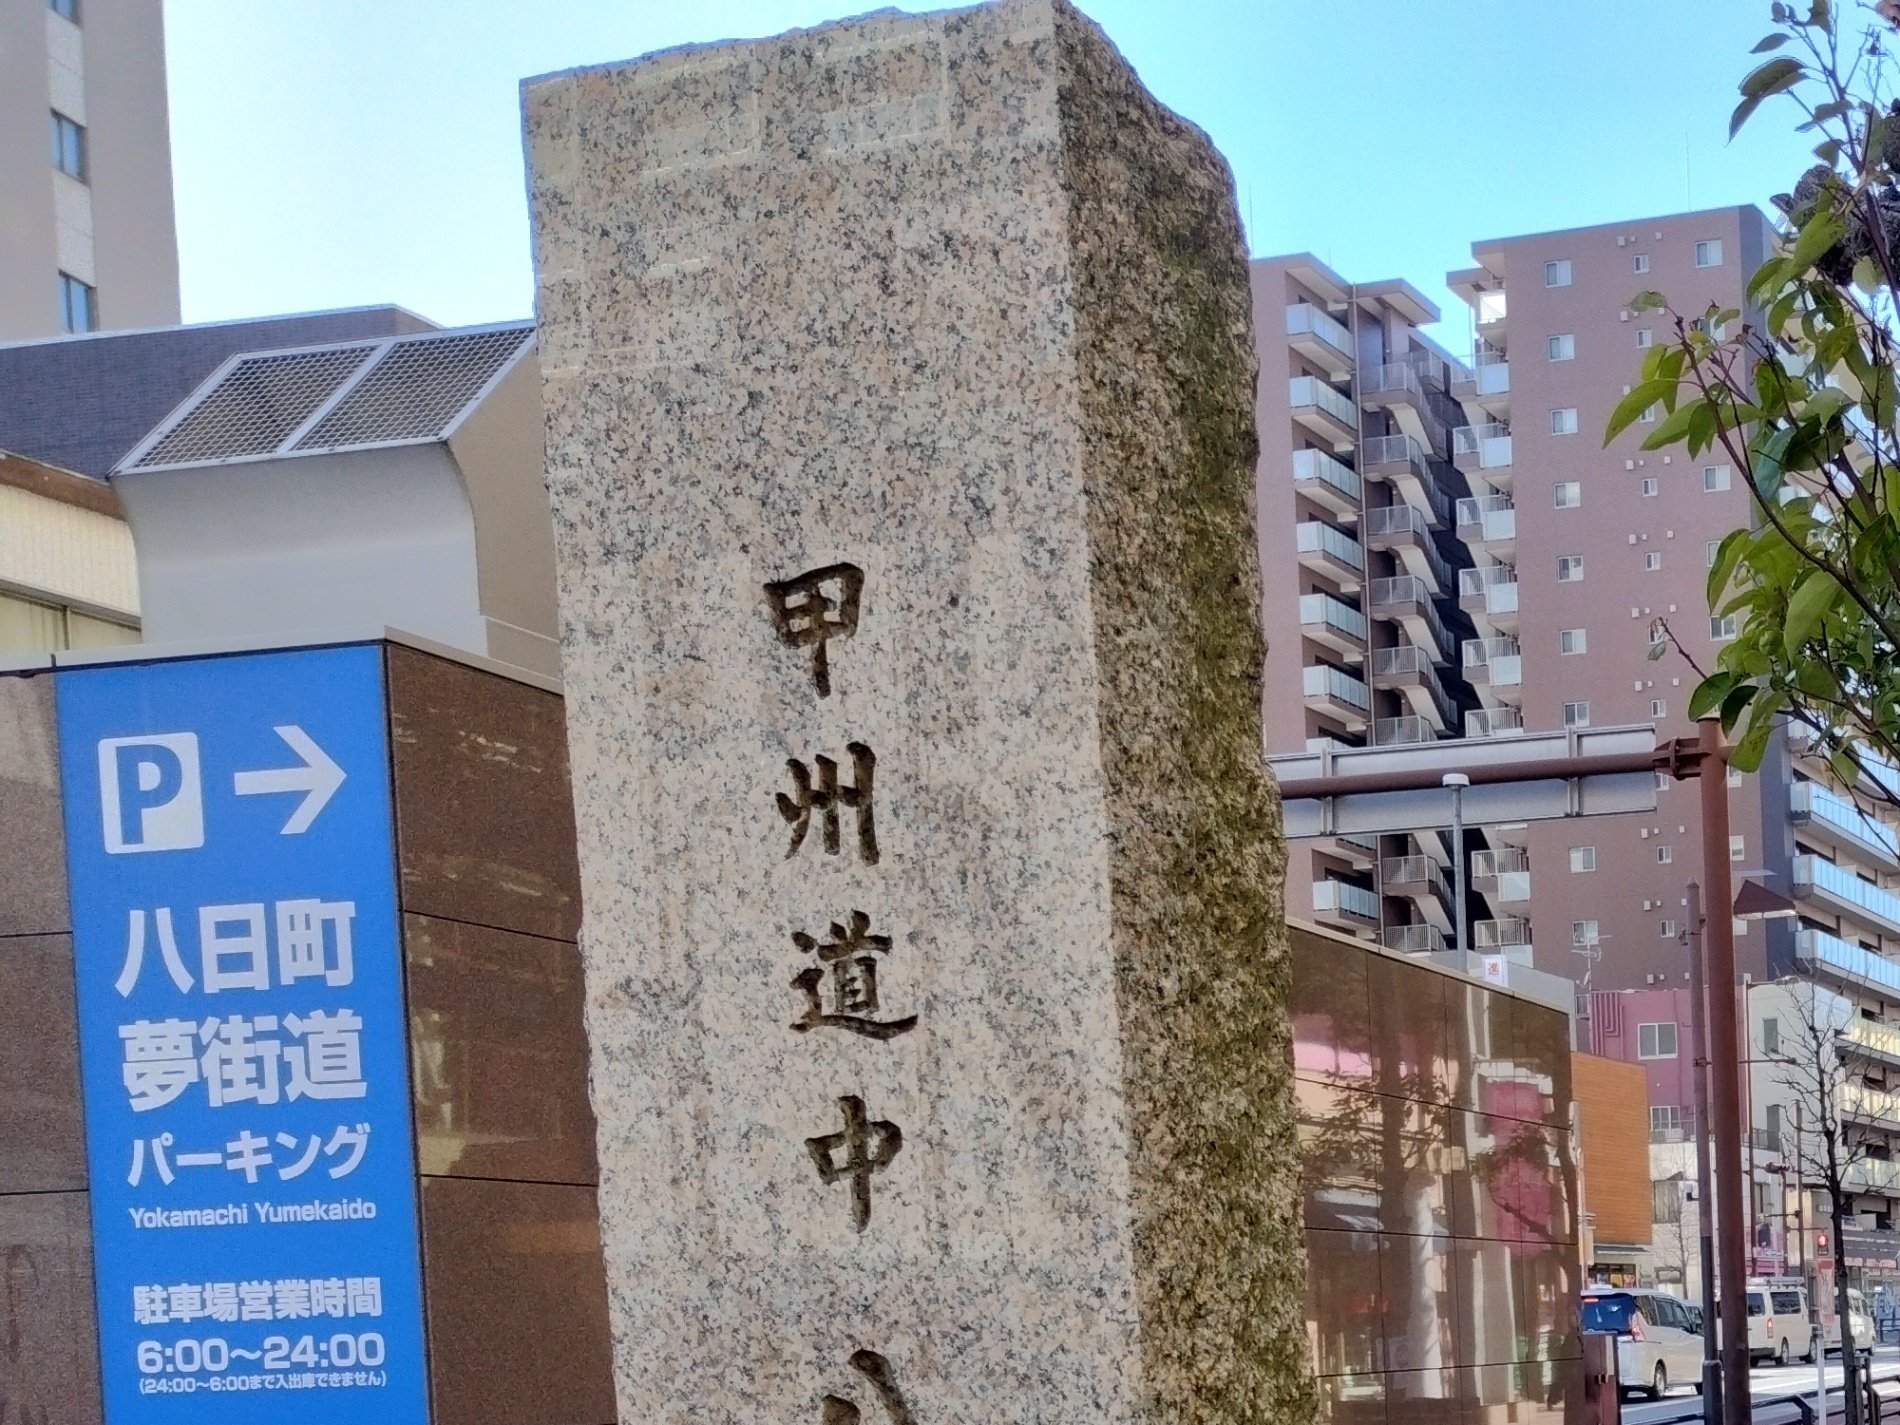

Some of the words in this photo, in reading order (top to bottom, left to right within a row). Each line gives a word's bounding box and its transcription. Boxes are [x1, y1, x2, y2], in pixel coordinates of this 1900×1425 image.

[115, 743, 183, 845] P
[115, 898, 356, 998] 八日町
[118, 1009, 367, 1113] 夢街道
[127, 1122, 371, 1187] パーキング
[129, 1203, 248, 1229] Yokamachi
[255, 1198, 377, 1225] Yumekaido
[133, 1277, 383, 1325] 駐車場営業時間
